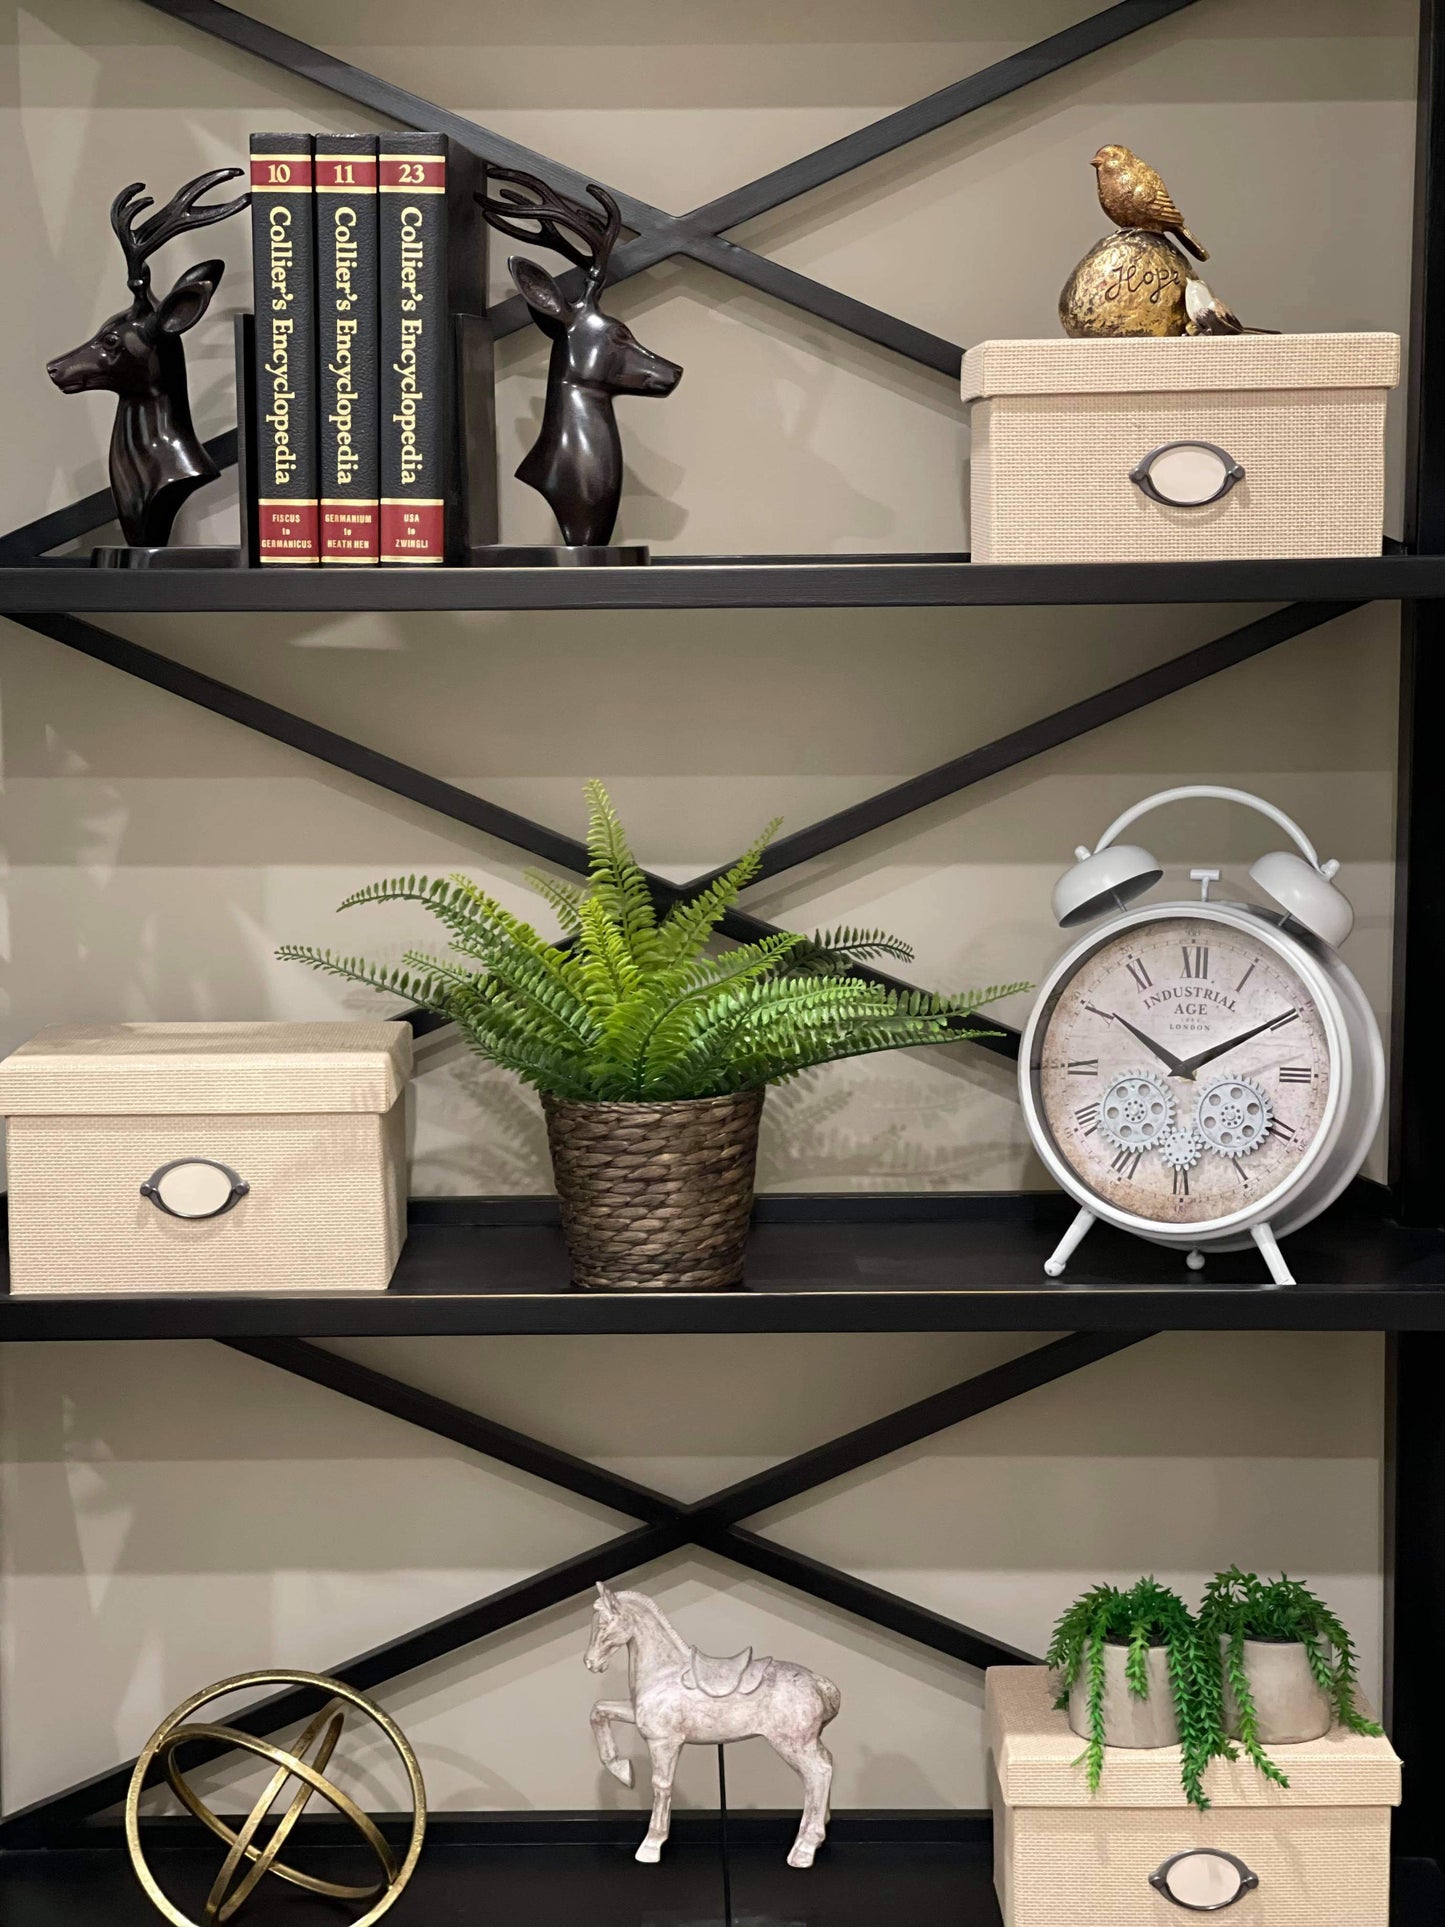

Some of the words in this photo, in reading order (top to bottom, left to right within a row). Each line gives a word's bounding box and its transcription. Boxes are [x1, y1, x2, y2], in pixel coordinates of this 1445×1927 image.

[267, 164, 291, 183] 10
[333, 164, 355, 184] 11
[398, 164, 426, 184] 23
[269, 206, 294, 311] Collier's
[334, 206, 358, 311] Collier's
[400, 206, 424, 312] Collier's
[1104, 264, 1181, 304] Hope
[265, 318, 297, 485] Encyclopedia
[328, 318, 359, 485] Encyclopedia
[392, 318, 423, 485] Encyclopedia
[272, 513, 301, 523] FISCUS
[324, 513, 372, 523] GERMANIUM
[403, 513, 420, 523] USA
[282, 527, 291, 536] to
[343, 527, 352, 536] to
[407, 527, 416, 536] to
[261, 539, 312, 549] GERMANICUS
[327, 539, 352, 549] HEATH
[354, 539, 370, 549] HEN
[395, 539, 429, 549] ZWINGLI
[1179, 946, 1209, 979] XII
[1143, 986, 1237, 1013] INDUSTRIAL
[1174, 1003, 1208, 1015] AGE
